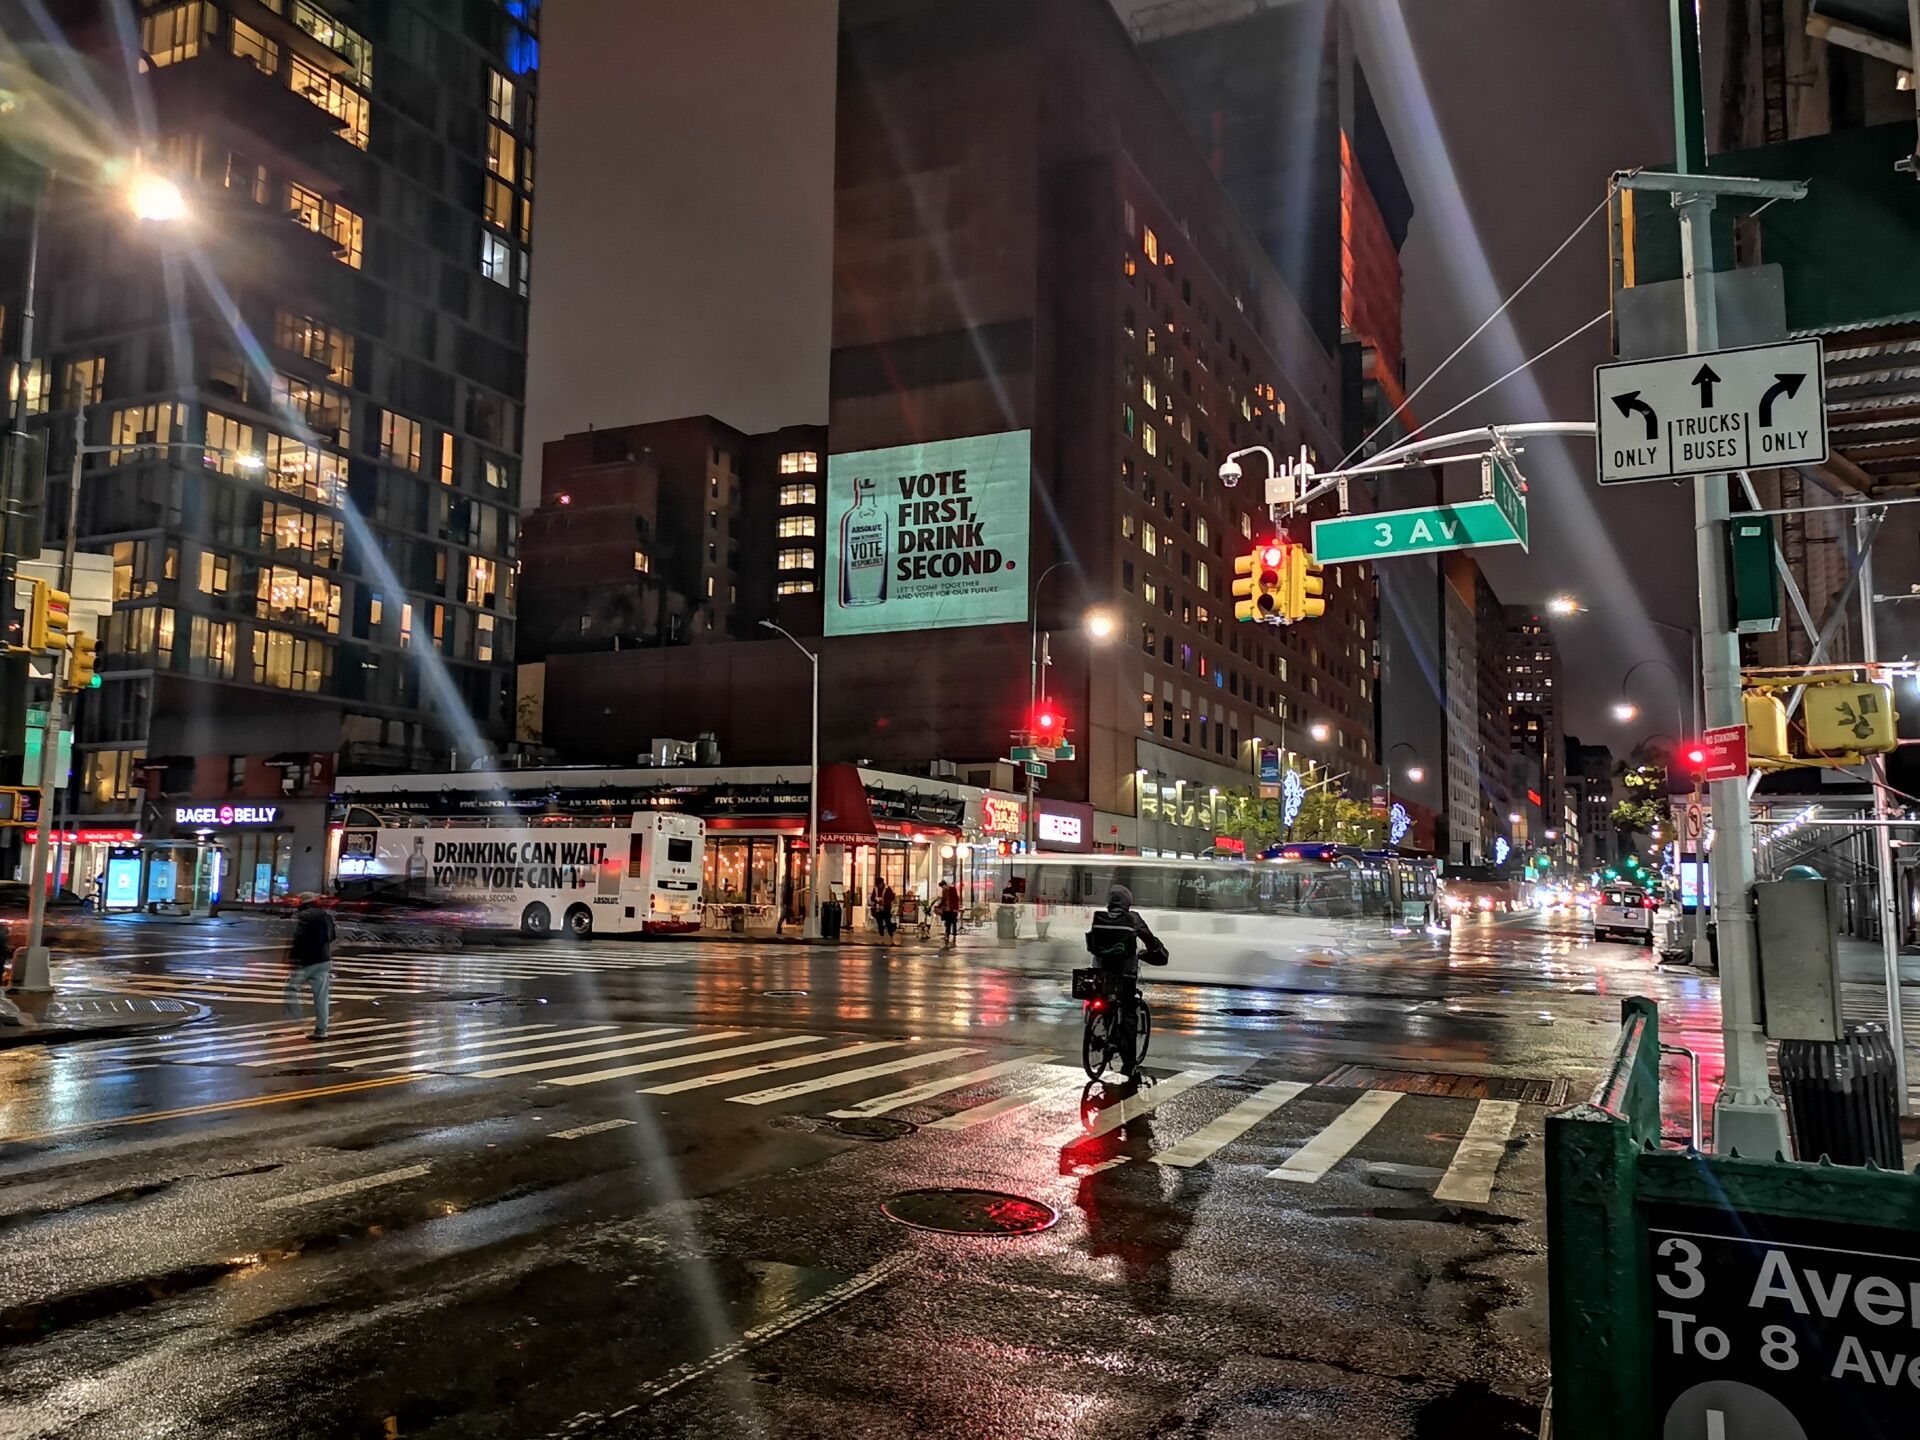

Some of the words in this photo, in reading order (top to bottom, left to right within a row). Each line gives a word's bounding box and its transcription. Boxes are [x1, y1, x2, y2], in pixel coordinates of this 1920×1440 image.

[1676, 412, 1741, 438] TRUCKS
[1683, 437, 1737, 462] BUSES
[1762, 430, 1808, 453] ONLY
[1614, 446, 1658, 469] ONLY
[898, 469, 967, 500] VOTE
[898, 497, 977, 528] FIRST,
[898, 522, 985, 555] DRINK
[1373, 522, 1394, 548] 3
[1408, 518, 1458, 545] Av
[851, 541, 883, 560] VOTE
[896, 592, 913, 601] AND
[914, 591, 934, 599] VOTE
[951, 588, 969, 596] OUR
[971, 586, 999, 594] FUTURE
[916, 584, 938, 592] COME
[941, 580, 980, 590] TOGETHER
[583, 798, 627, 806] AMERICAN
[715, 796, 734, 804] FIVE
[737, 795, 769, 804] NAPKIN
[773, 795, 809, 803] BURGER
[175, 807, 220, 823] BAGEL
[233, 807, 277, 823] BELLY
[819, 834, 855, 843] NAPKIN
[434, 842, 517, 864] DRINKING
[521, 842, 556, 865] CAN
[561, 842, 609, 865] WAIT.
[432, 865, 478, 888] YOUR
[481, 865, 523, 889] VOTE
[1656, 1237, 1706, 1300] 3
[1748, 1250, 1920, 1330] Ave
[1657, 1309, 1731, 1362] To
[1759, 1324, 1800, 1372] 8
